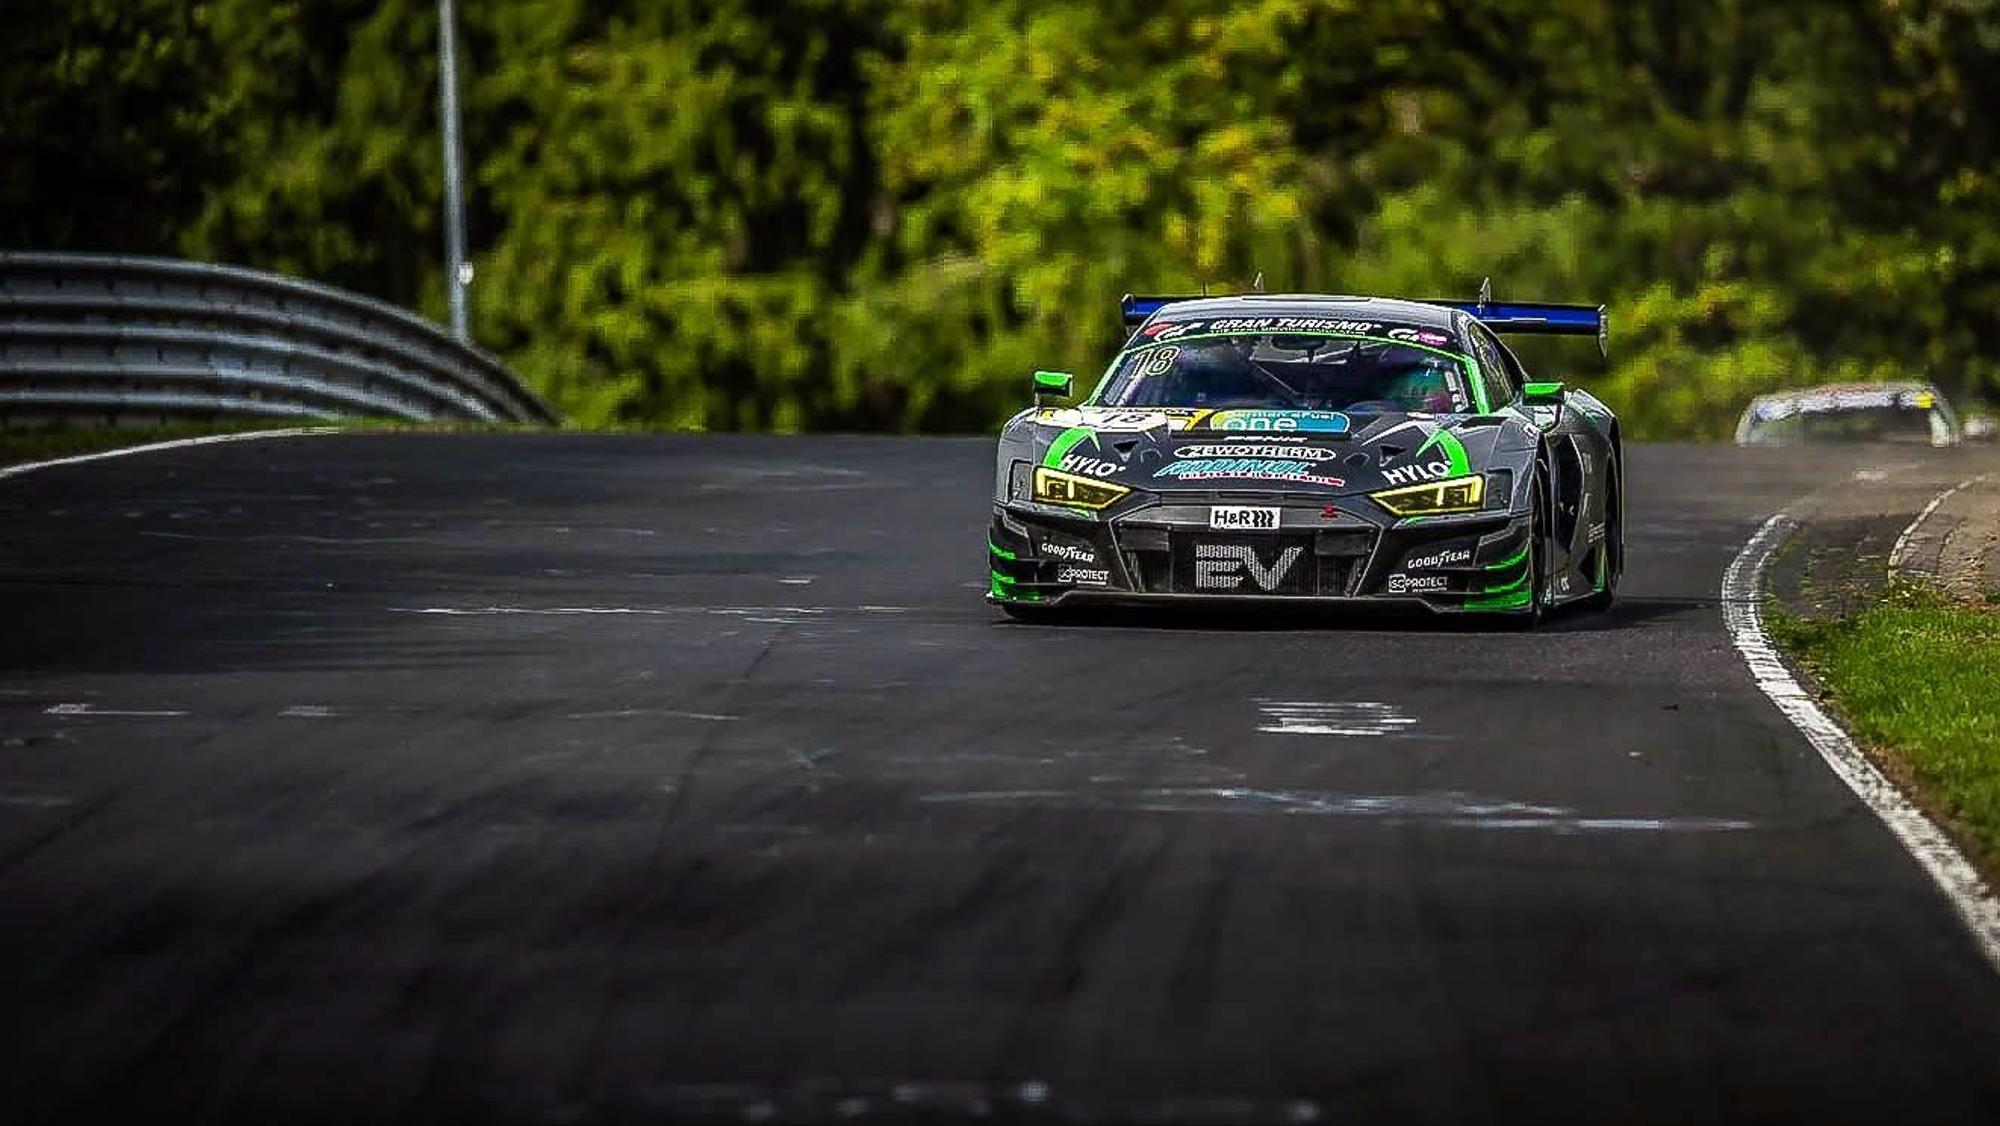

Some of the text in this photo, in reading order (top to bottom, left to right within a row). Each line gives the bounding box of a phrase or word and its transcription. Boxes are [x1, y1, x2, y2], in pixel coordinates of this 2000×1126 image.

[1210, 318, 1272, 330] GRAN
[1276, 318, 1372, 332] TURISMO
[1131, 346, 1180, 377] 18
[1222, 417, 1298, 431] one
[1381, 461, 1449, 485] HYLO
[1214, 510, 1251, 526] H&R
[1041, 543, 1095, 563] GOODYEAR
[1407, 549, 1471, 569] GOODYEAR
